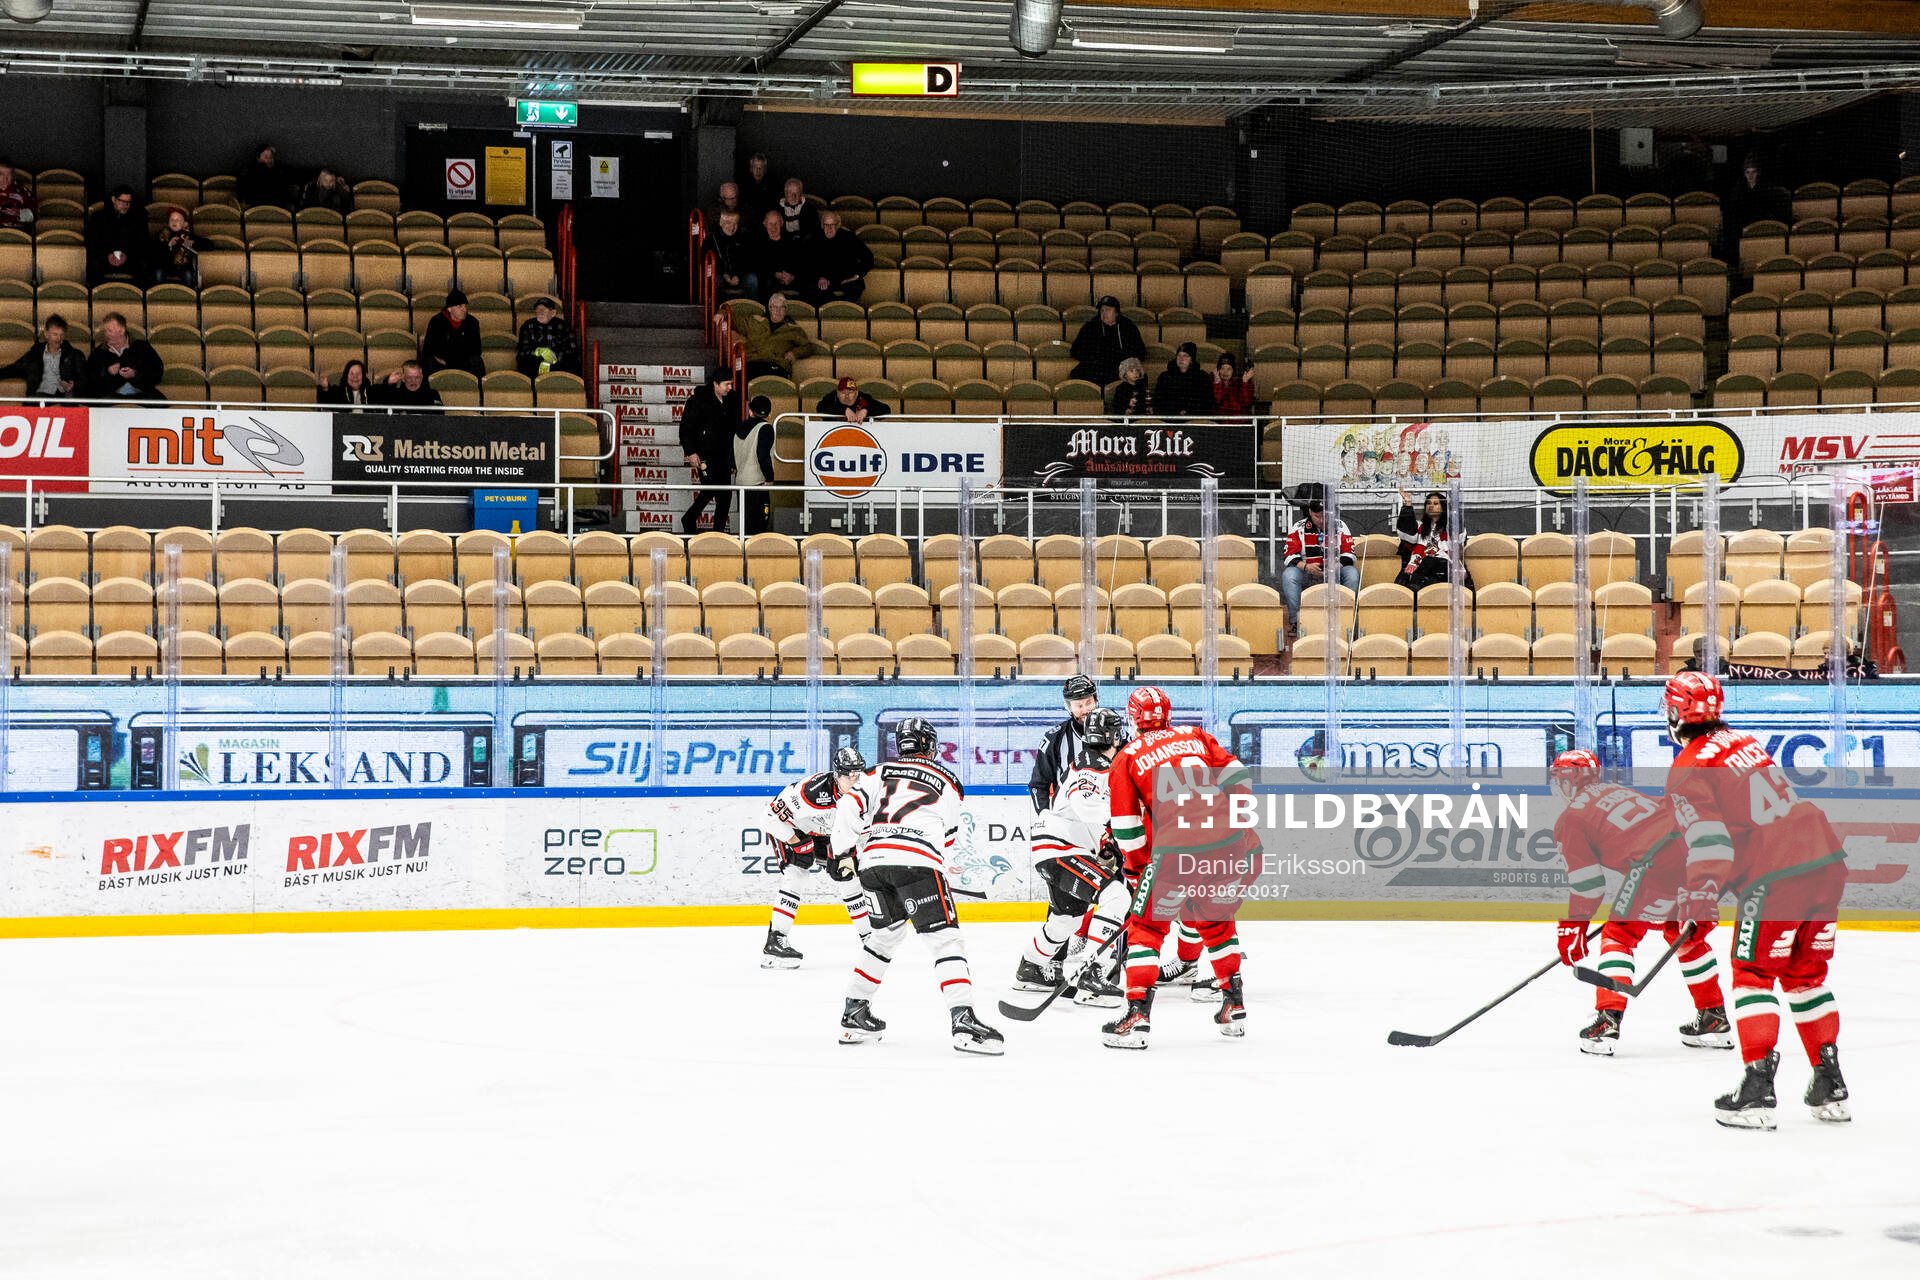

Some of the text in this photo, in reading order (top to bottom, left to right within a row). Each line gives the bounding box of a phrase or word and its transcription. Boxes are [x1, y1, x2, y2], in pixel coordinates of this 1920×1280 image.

[927, 66, 953, 93] D
[608, 366, 636, 375] MAXI
[663, 367, 691, 376] MAXI
[610, 385, 642, 395] MAXI
[666, 386, 694, 396] MAX
[623, 426, 655, 436] MAXI
[128, 417, 224, 465] mit
[394, 439, 545, 461] Mattsson Metal
[1066, 429, 1194, 457] Mora Life
[1780, 435, 1870, 460] MSV
[627, 447, 659, 457] MAXI
[814, 451, 882, 472] Gulf
[365, 465, 524, 475] QUALITY STARTING FROM THE INSIDE
[902, 453, 984, 473] IDRE
[635, 468, 667, 478] MAXI
[636, 491, 669, 501] MAXI
[640, 512, 672, 522] MAXI
[218, 738, 280, 749] MAGASIN
[1135, 739, 1206, 776] JOHANSSON
[100, 823, 251, 875] RIXFM
[286, 821, 432, 872] RIXFM
[544, 829, 602, 852] pre
[284, 861, 428, 888] BÄST MUSIK JUST NU!
[544, 857, 625, 875] zero
[98, 863, 248, 891] BÄST MUSIK JUST NU!
[1493, 872, 1537, 884] SPORTS
